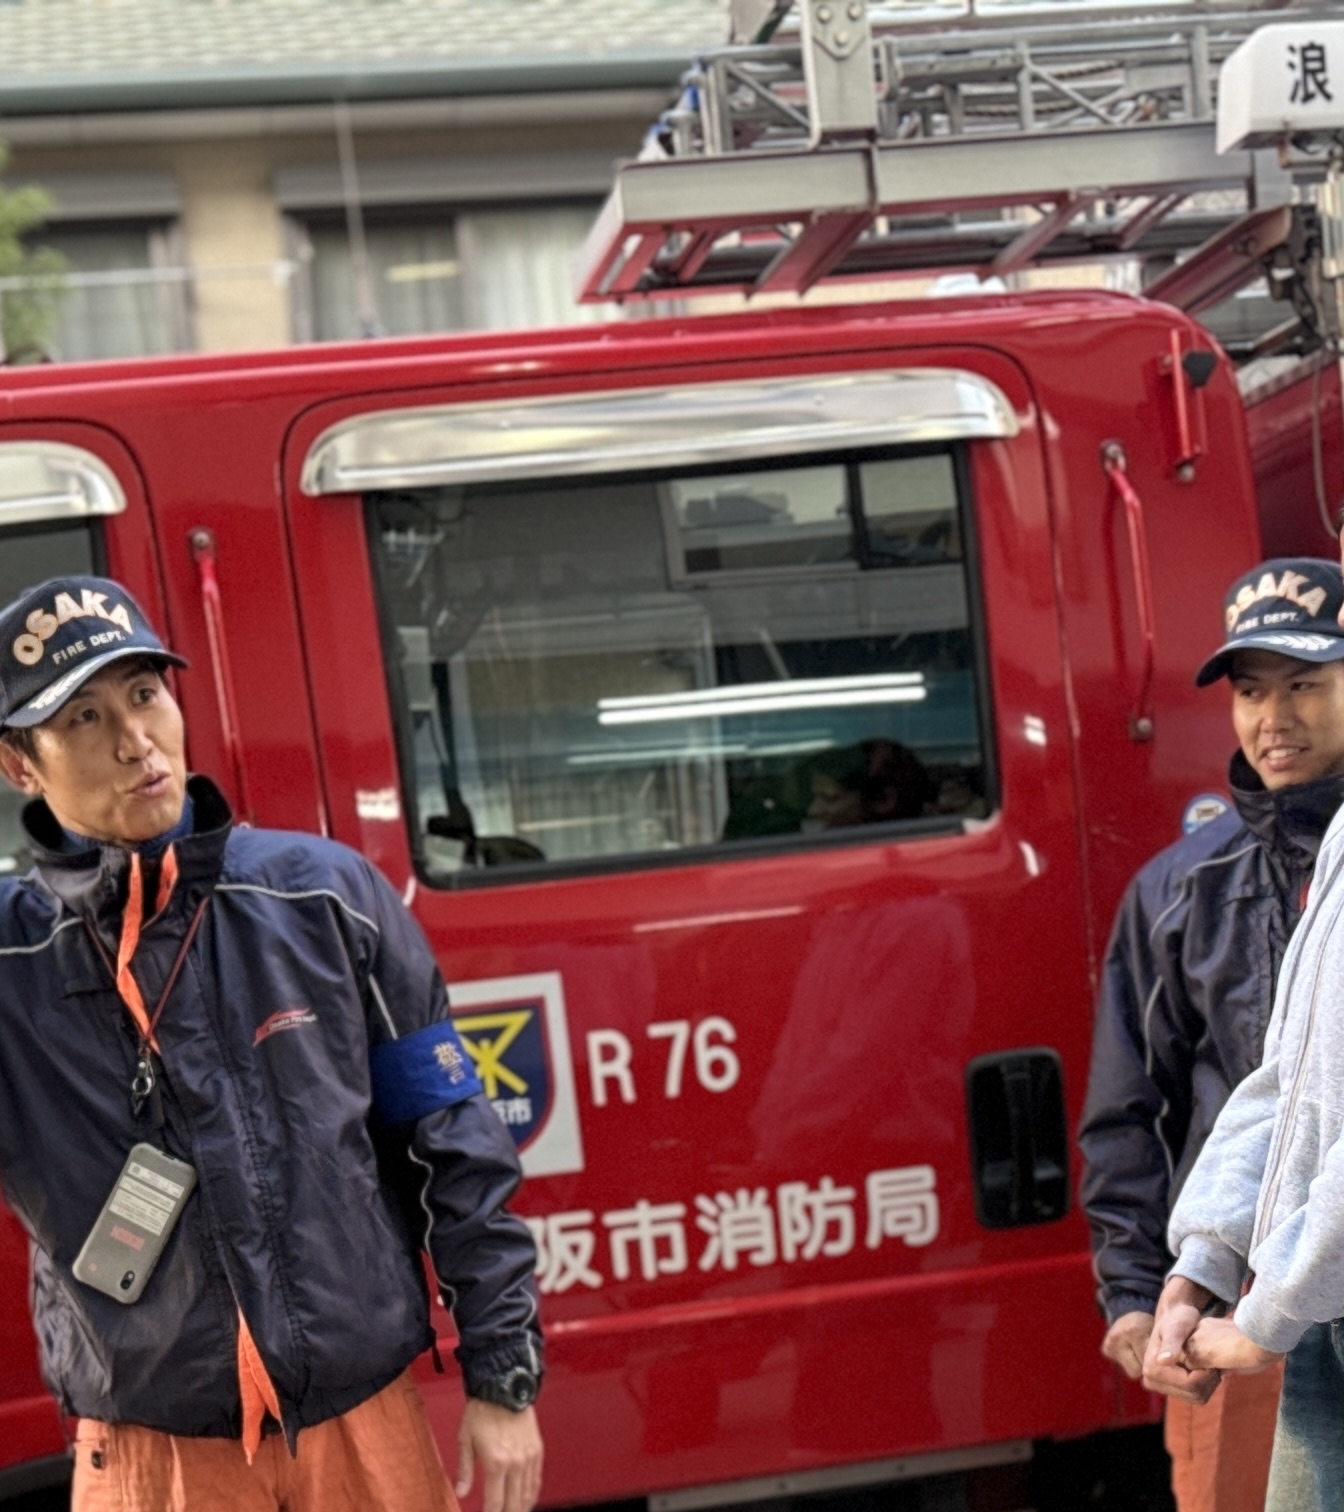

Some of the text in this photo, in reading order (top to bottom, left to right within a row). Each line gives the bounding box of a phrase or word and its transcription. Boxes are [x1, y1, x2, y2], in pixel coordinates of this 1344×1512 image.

[13, 589, 133, 666] OSAKA
[1226, 570, 1328, 633] OSAKA
[52, 630, 126, 665] FIRE DEPT.
[586, 1015, 740, 1107] R 76
